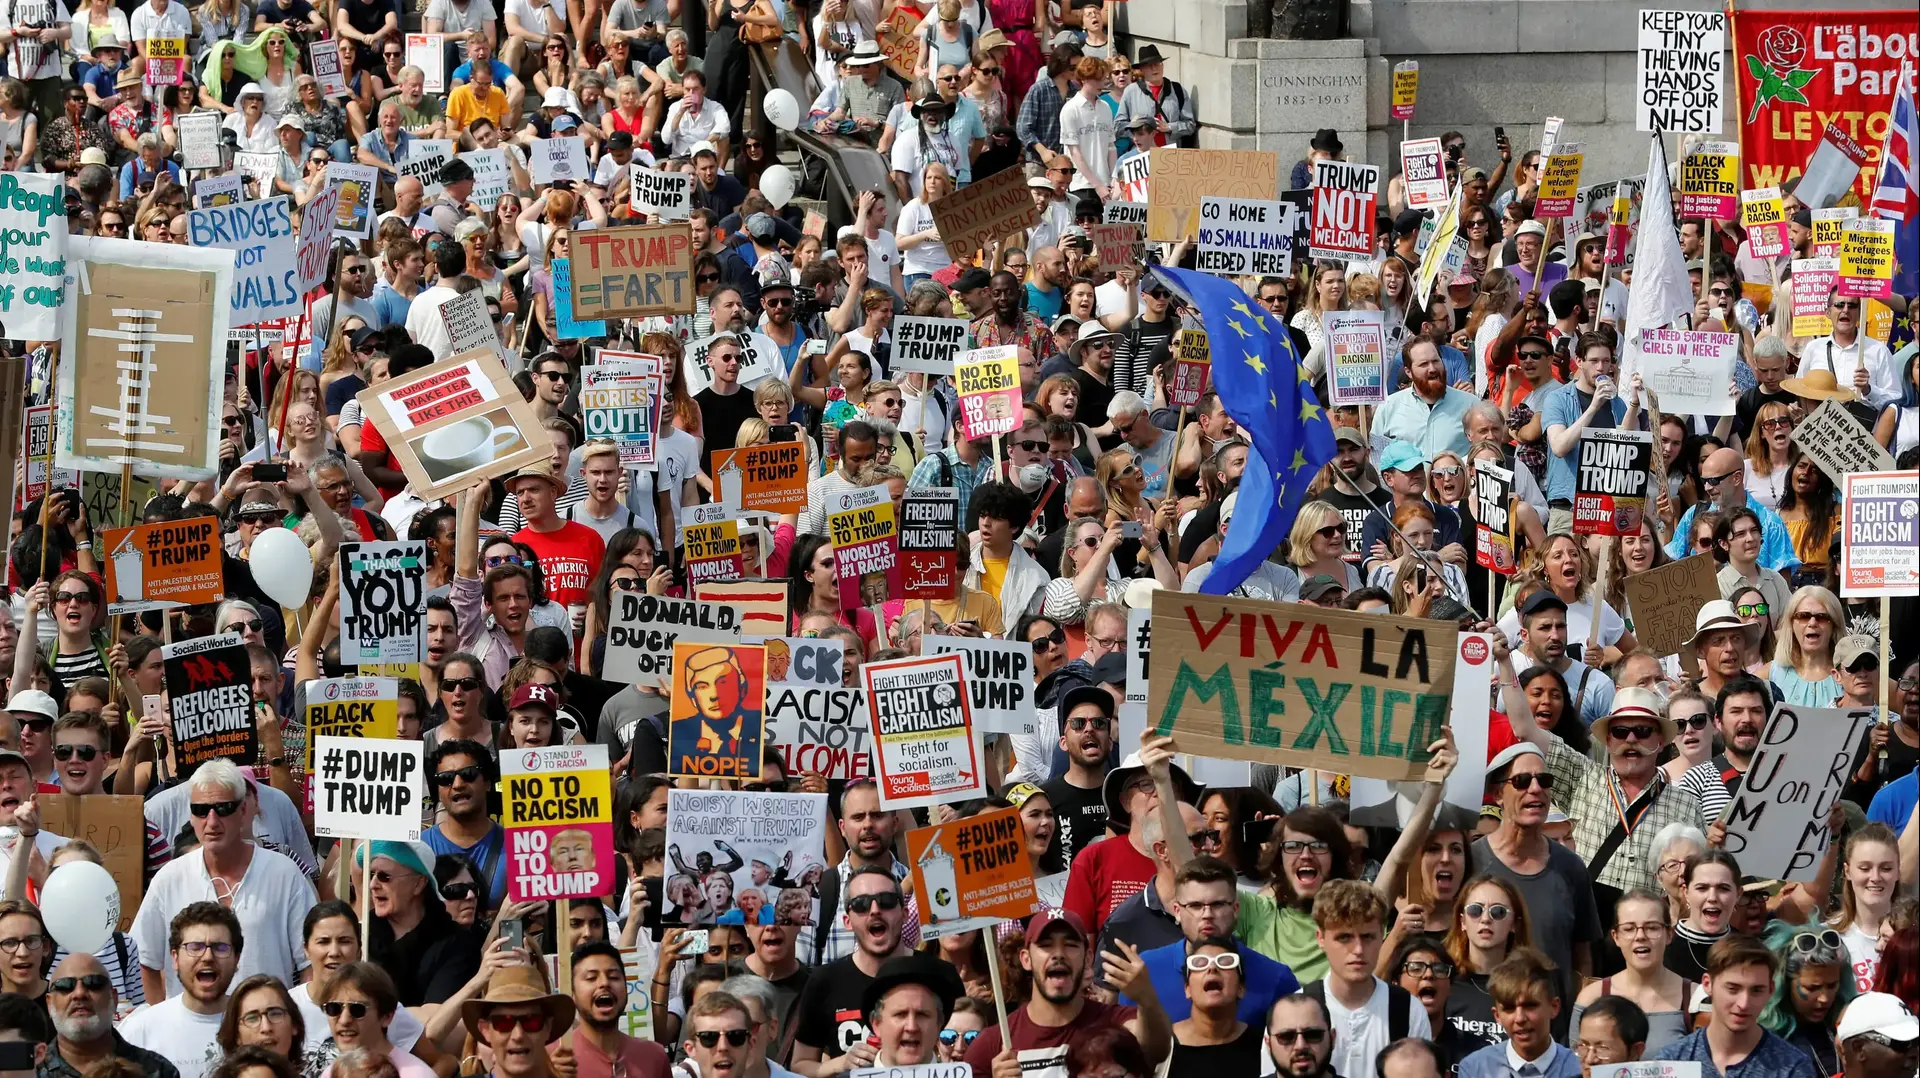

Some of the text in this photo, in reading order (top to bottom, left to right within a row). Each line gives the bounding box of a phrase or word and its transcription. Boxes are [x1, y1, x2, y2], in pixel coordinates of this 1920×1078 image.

[1642, 12, 1723, 30] KEEP YOUR
[1824, 25, 1852, 34] THE
[1659, 31, 1706, 49] TINY
[150, 48, 179, 56] RACISM
[315, 53, 331, 65] FIGHT
[1642, 49, 1720, 72] THIEVING
[149, 59, 160, 68] NO
[150, 75, 177, 84] TRUMP
[1264, 75, 1363, 88] CUNNINGHAM
[1645, 72, 1715, 92] HANDS
[1643, 90, 1718, 108] OFF OUR
[1649, 108, 1711, 132] NHS!
[1552, 158, 1578, 166] Migrants
[1686, 156, 1725, 168] BLACK
[635, 171, 686, 192] #DUMP
[1317, 163, 1377, 192] TRUMP
[1408, 167, 1437, 181] SEXISM
[1548, 178, 1574, 186] welcome
[1685, 168, 1719, 180] LIVES
[201, 180, 236, 192] STOP TRUMP
[1551, 188, 1567, 196] here
[1685, 181, 1734, 194] MATTER
[636, 187, 682, 208] TRUMP
[1695, 197, 1721, 205] justice
[1202, 202, 1220, 219] GO
[1230, 203, 1266, 222] HOME
[1316, 190, 1374, 229] NOT
[1746, 203, 1771, 213] NO TO
[1748, 210, 1780, 223] RACISM
[190, 201, 292, 246] BRIDGES
[1749, 226, 1761, 237] NO
[1200, 229, 1293, 250] NO SMALL HANDS
[1314, 228, 1370, 250] WELCOME
[1751, 237, 1762, 245] TO
[1848, 233, 1887, 244] Migrants
[580, 234, 688, 269] TRUMP
[1312, 249, 1371, 261] TOGETHER AGAINST TRUMP
[1752, 244, 1783, 256] TRUMP
[1853, 246, 1891, 256] refugees
[1199, 251, 1285, 273] NEEDED HERE
[1848, 256, 1886, 265] welcome
[1794, 273, 1833, 283] Solidarity
[1856, 266, 1875, 275] here
[1795, 284, 1827, 293] with the
[899, 322, 965, 342] #DUMP
[1333, 334, 1377, 344] SOLIDARITY
[1642, 329, 1734, 346] WE NEED SOME MORE
[1346, 343, 1367, 353] NOT
[1642, 341, 1720, 358] GIRLS IN HERE
[1341, 355, 1373, 364] RACISM!
[960, 364, 1002, 380] NO TO
[1338, 366, 1379, 376] SOCIALISM
[390, 368, 470, 400] TRUMP WOULD
[961, 374, 1013, 392] RACISM
[1349, 377, 1369, 386] NOT
[404, 380, 471, 409] MAKE TEA
[586, 388, 647, 407] TORIES
[1338, 387, 1380, 397] TRUMPISM!
[409, 391, 484, 426] LIKE THIS
[588, 408, 646, 433] OUT!
[968, 416, 1014, 438] TRUMP
[1593, 432, 1641, 441] Socialist Worker
[1581, 442, 1638, 469] DUMP
[1580, 466, 1645, 494] TRUMP
[1852, 484, 1918, 496] FIGHT TRUMPISM
[905, 503, 954, 521] FREEDOM
[1577, 498, 1601, 509] FIGHT
[1852, 502, 1896, 522] FIGHT
[1576, 508, 1612, 522] BIGOTRY
[147, 524, 212, 548] #DUMP
[687, 527, 722, 544] SAY NO
[834, 521, 893, 544] TO TRUMP
[902, 530, 955, 548] PALESTINE
[1852, 522, 1912, 542] RACISM
[148, 543, 211, 567] TRUMP
[688, 538, 737, 558] TO TRUMP
[838, 541, 889, 564] WORLD'S
[363, 558, 401, 569] THANK
[552, 562, 588, 575] AMERICA
[911, 556, 945, 572] الحرية
[905, 573, 949, 592] لفلسطين
[172, 637, 237, 656] Socialist Worker
[1184, 605, 1431, 684] VIVA LA
[172, 684, 249, 719] REFUGEES
[877, 687, 929, 715] FIGHT
[310, 703, 375, 726] BLACK
[879, 706, 964, 734] CAPITALISM
[1155, 659, 1449, 764] MÉXICO
[174, 706, 250, 742] WELCOME
[543, 752, 570, 760] STAND
[556, 759, 588, 768] RACISM
[898, 755, 956, 772] socialism.
[322, 749, 416, 782] #DUMP
[682, 755, 749, 776] NOPE
[511, 776, 580, 800] NO TO
[892, 782, 930, 794] Socialists
[1777, 780, 1808, 805] on
[324, 782, 411, 815] TRUMP
[512, 798, 599, 822] RACISM
[1082, 805, 1105, 814] NEVER
[408, 830, 419, 840] FOA
[673, 815, 817, 837] AGAINST TRUMP
[513, 830, 547, 852] NO
[514, 853, 546, 876] TO
[516, 872, 599, 898] TRUMP
